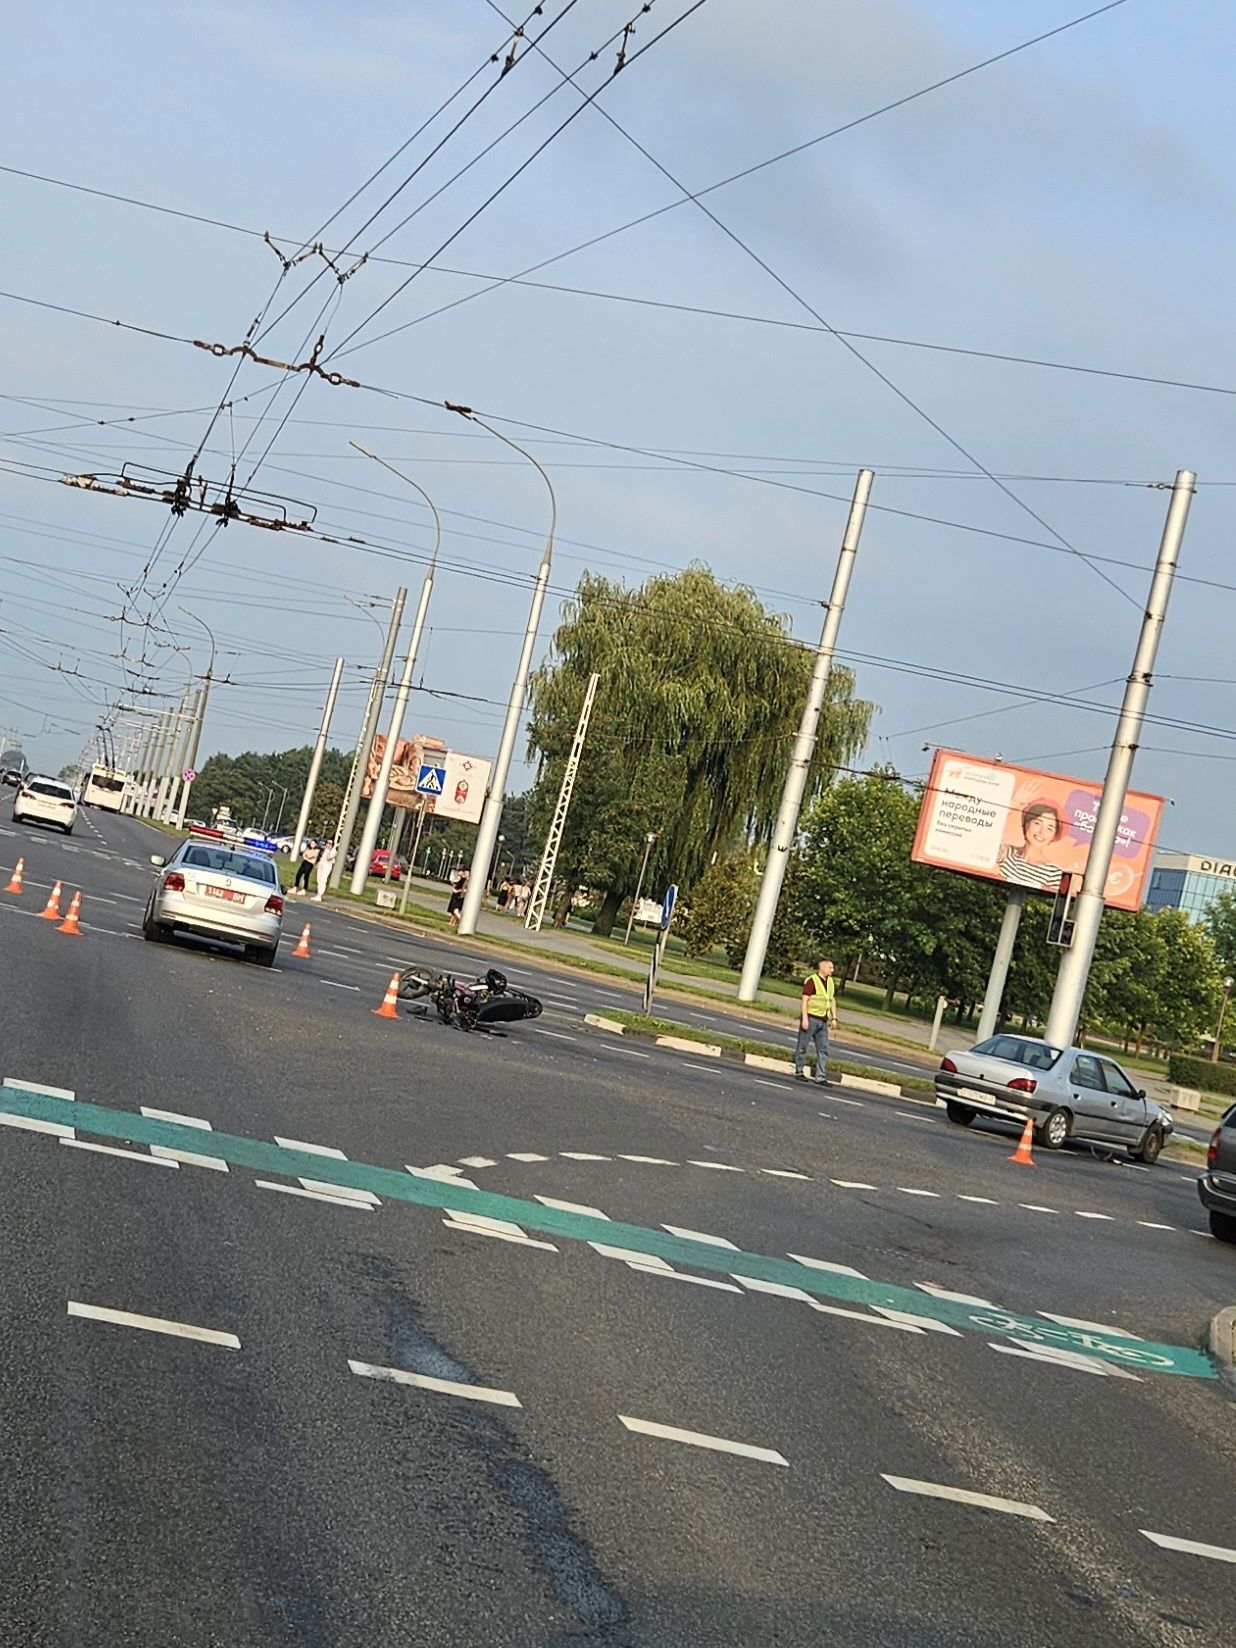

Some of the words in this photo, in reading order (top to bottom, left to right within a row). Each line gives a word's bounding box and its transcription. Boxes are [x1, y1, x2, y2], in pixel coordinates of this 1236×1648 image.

[945, 787, 982, 805] Мду
[941, 800, 996, 817] народные
[939, 810, 993, 828] переводы
[1201, 861, 1236, 876] DIA
